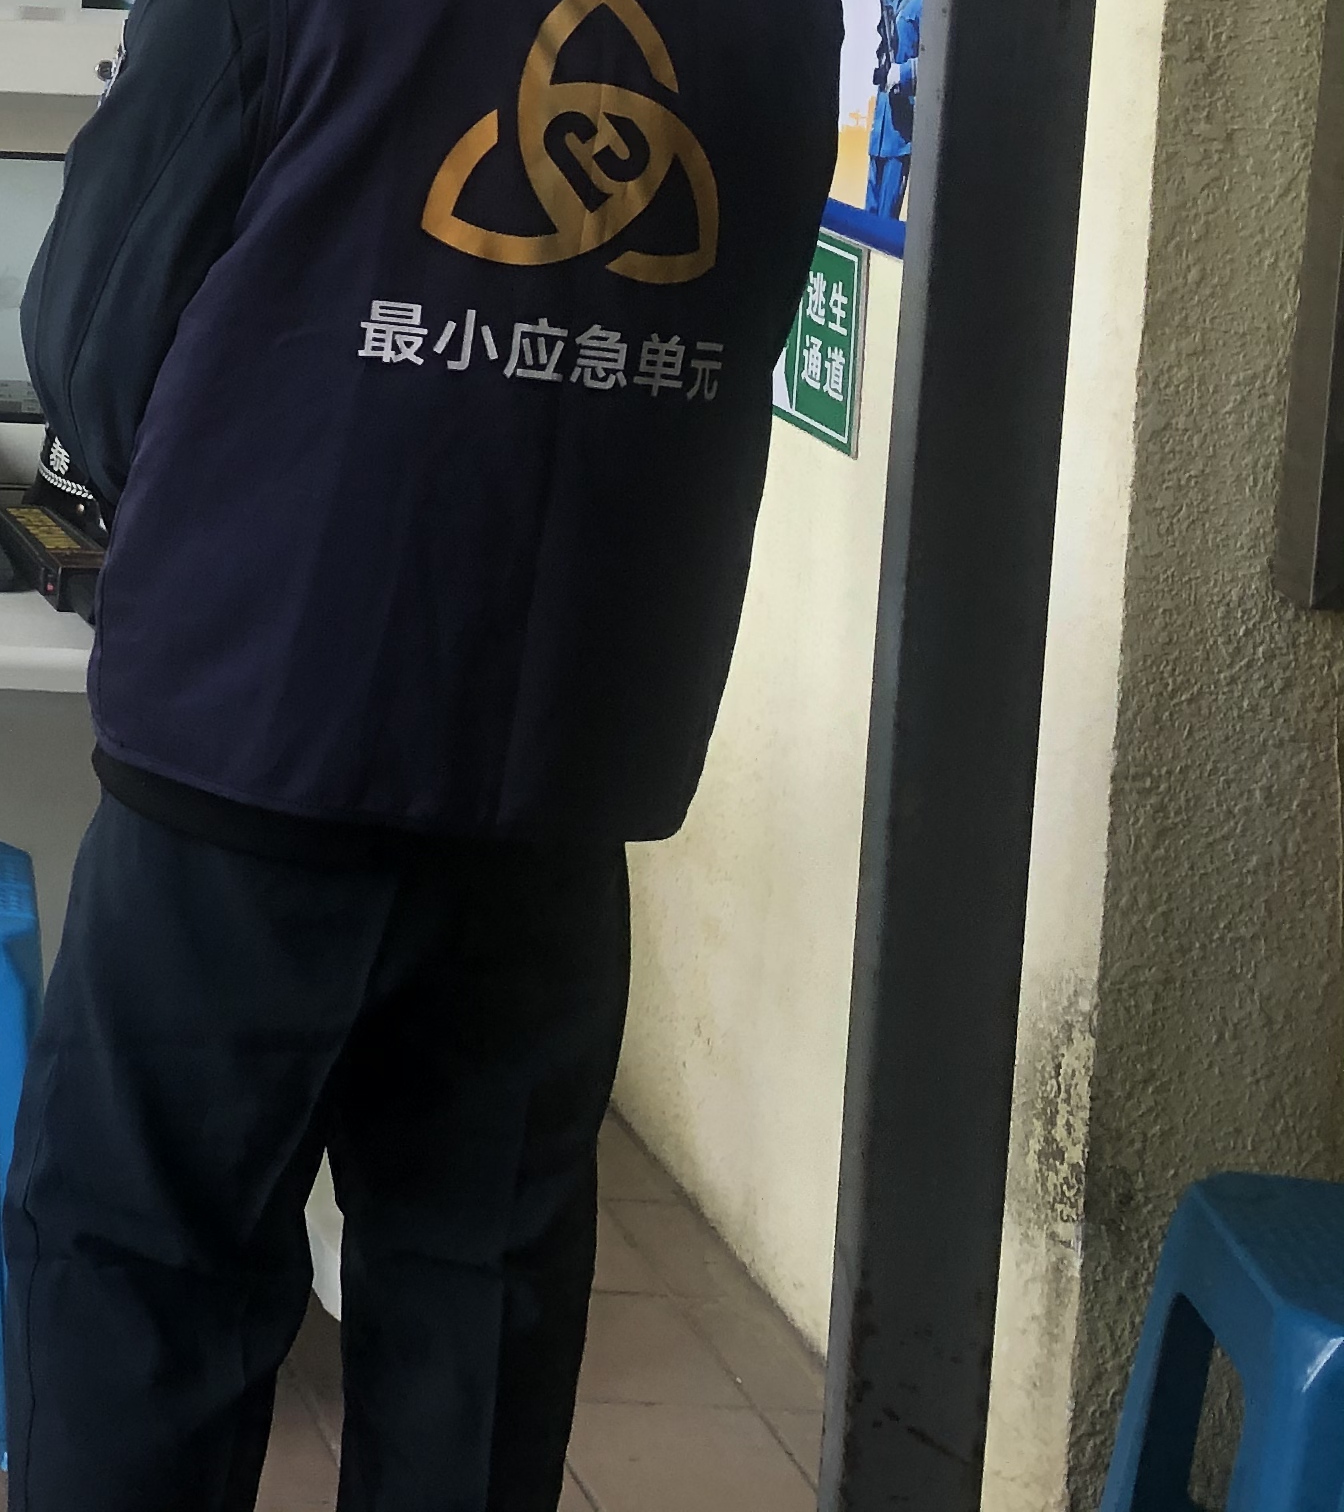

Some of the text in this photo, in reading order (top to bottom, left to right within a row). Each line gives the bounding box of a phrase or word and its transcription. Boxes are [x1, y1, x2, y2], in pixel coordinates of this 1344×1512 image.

[806, 270, 849, 336] 逃生
[357, 299, 725, 400] 最小应急单元
[801, 334, 847, 402] 通道
